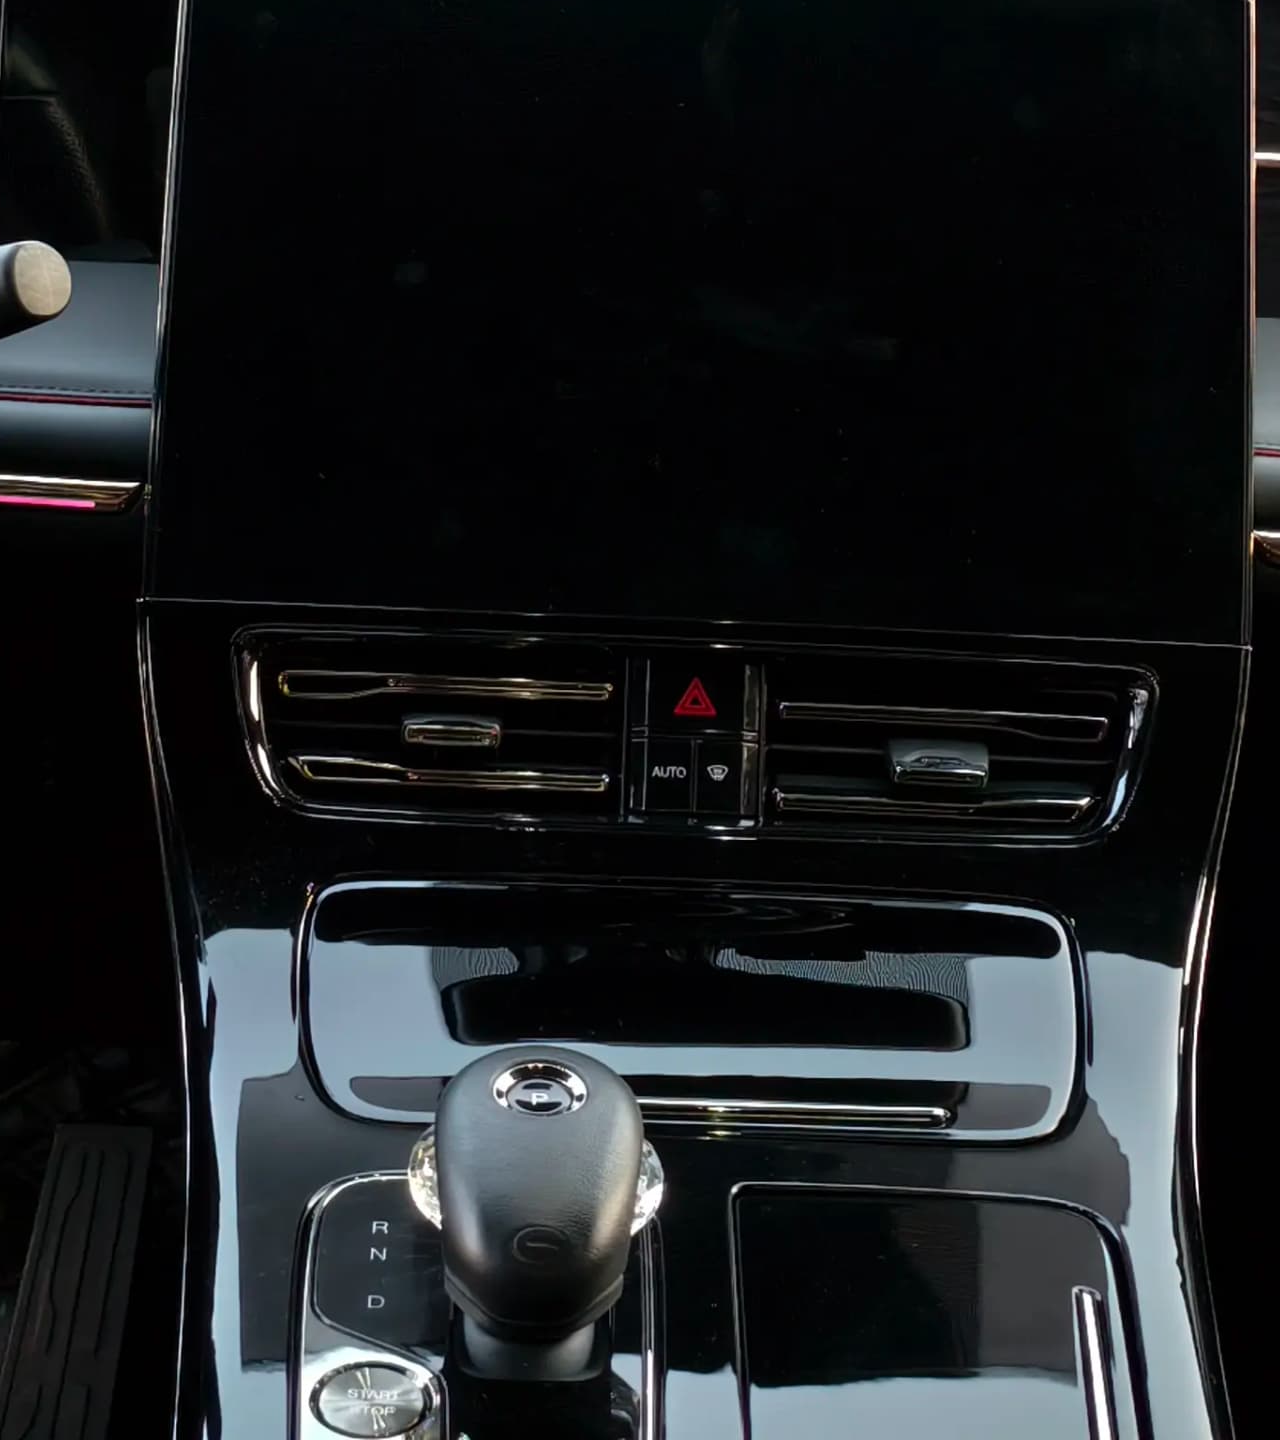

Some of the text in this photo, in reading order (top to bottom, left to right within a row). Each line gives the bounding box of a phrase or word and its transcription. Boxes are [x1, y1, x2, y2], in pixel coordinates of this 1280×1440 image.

[651, 766, 687, 779] AUTO
[531, 1093, 549, 1106] P
[372, 1220, 389, 1235] R
[370, 1247, 387, 1261] N
[367, 1294, 385, 1309] D
[347, 1388, 399, 1401] START
